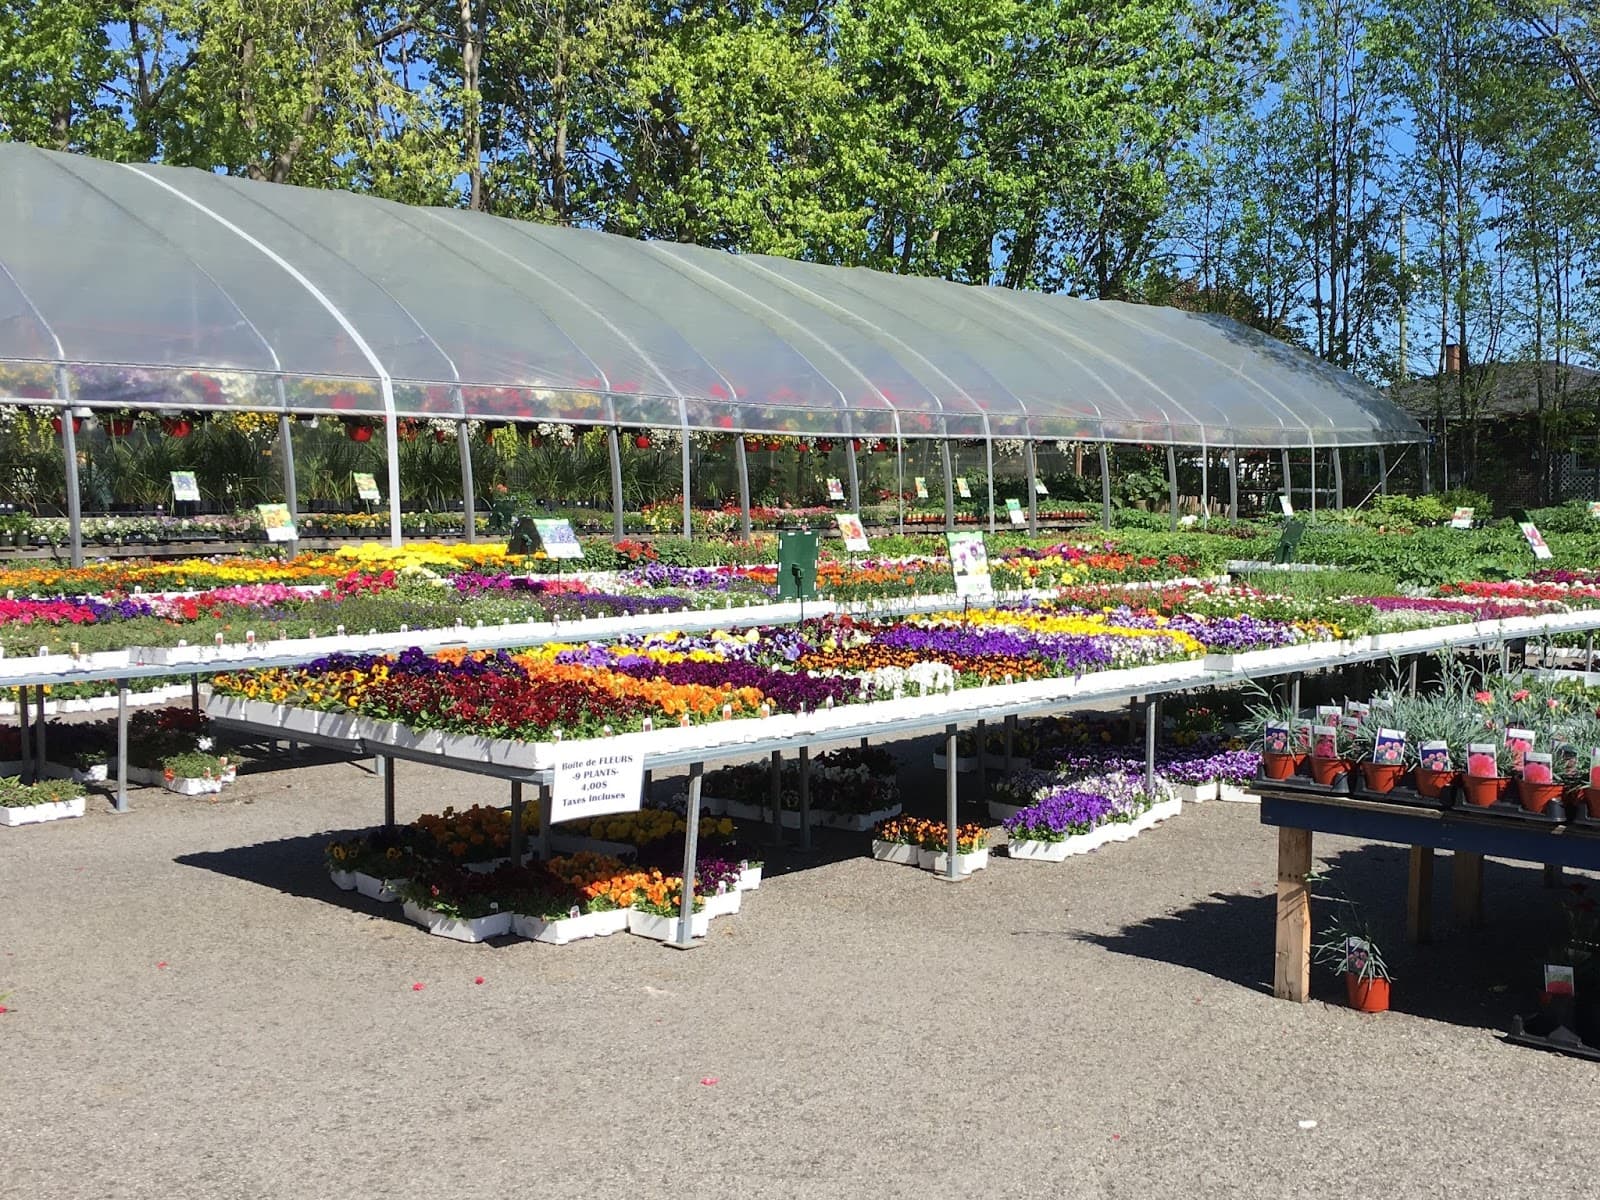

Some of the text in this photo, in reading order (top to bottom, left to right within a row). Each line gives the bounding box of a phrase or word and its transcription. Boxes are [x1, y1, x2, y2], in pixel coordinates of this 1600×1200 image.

[586, 759, 596, 767] de
[599, 755, 632, 765] FLEURS
[563, 797, 585, 807] Taxes
